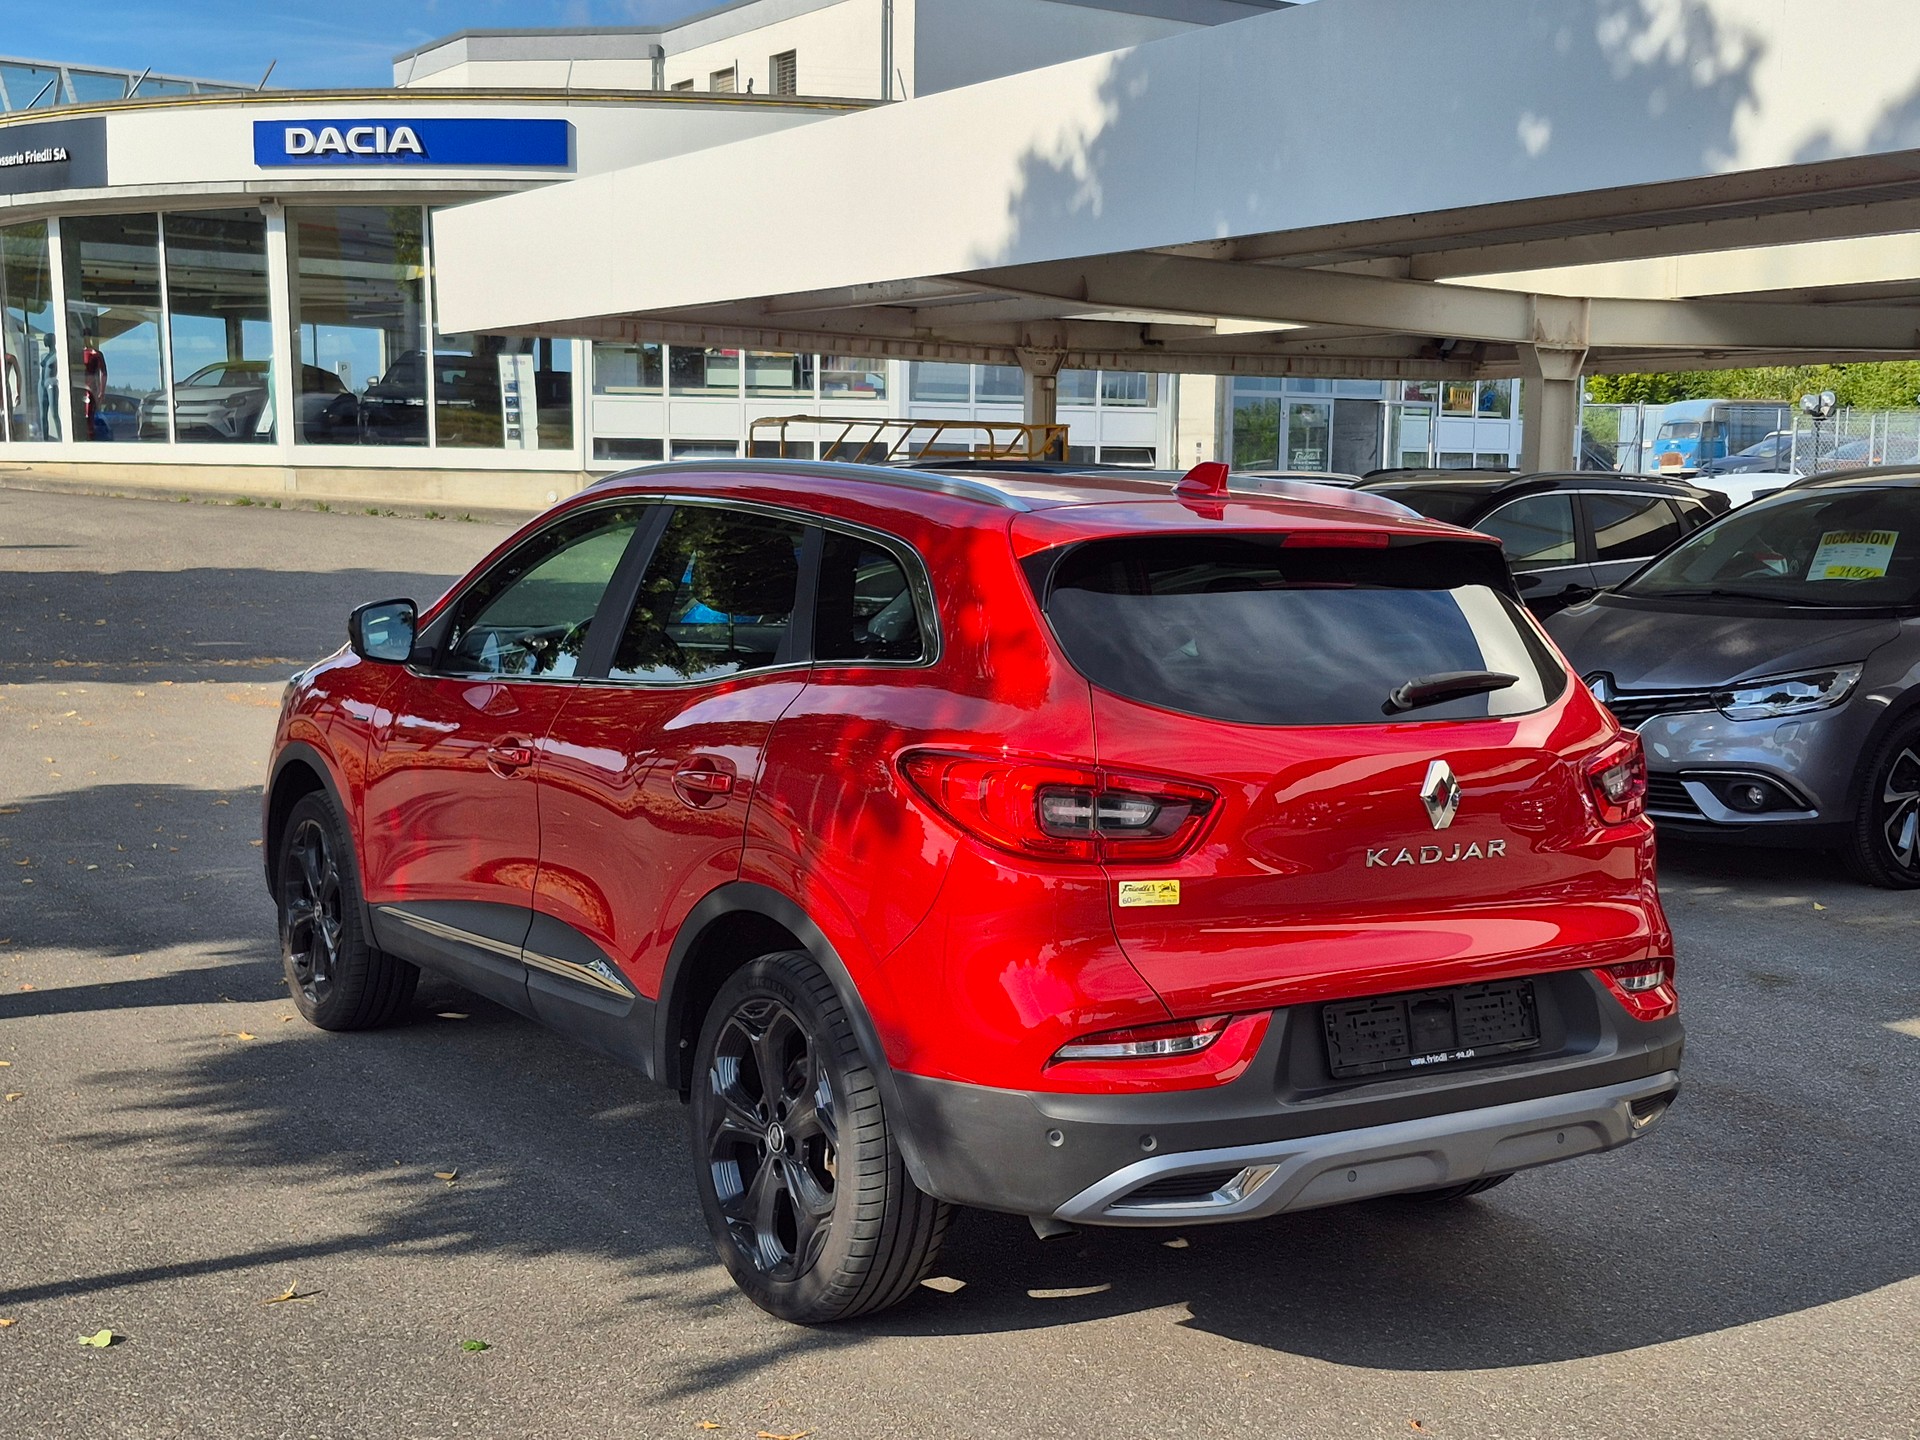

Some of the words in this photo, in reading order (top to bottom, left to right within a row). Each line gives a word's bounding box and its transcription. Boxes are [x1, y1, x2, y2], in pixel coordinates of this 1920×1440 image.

[285, 126, 423, 154] DACIA
[0, 149, 24, 166] sserie
[25, 148, 52, 164] Friedli
[53, 147, 67, 161] SA
[1824, 532, 1891, 545] OCCASION
[1365, 839, 1507, 867] KADJAR
